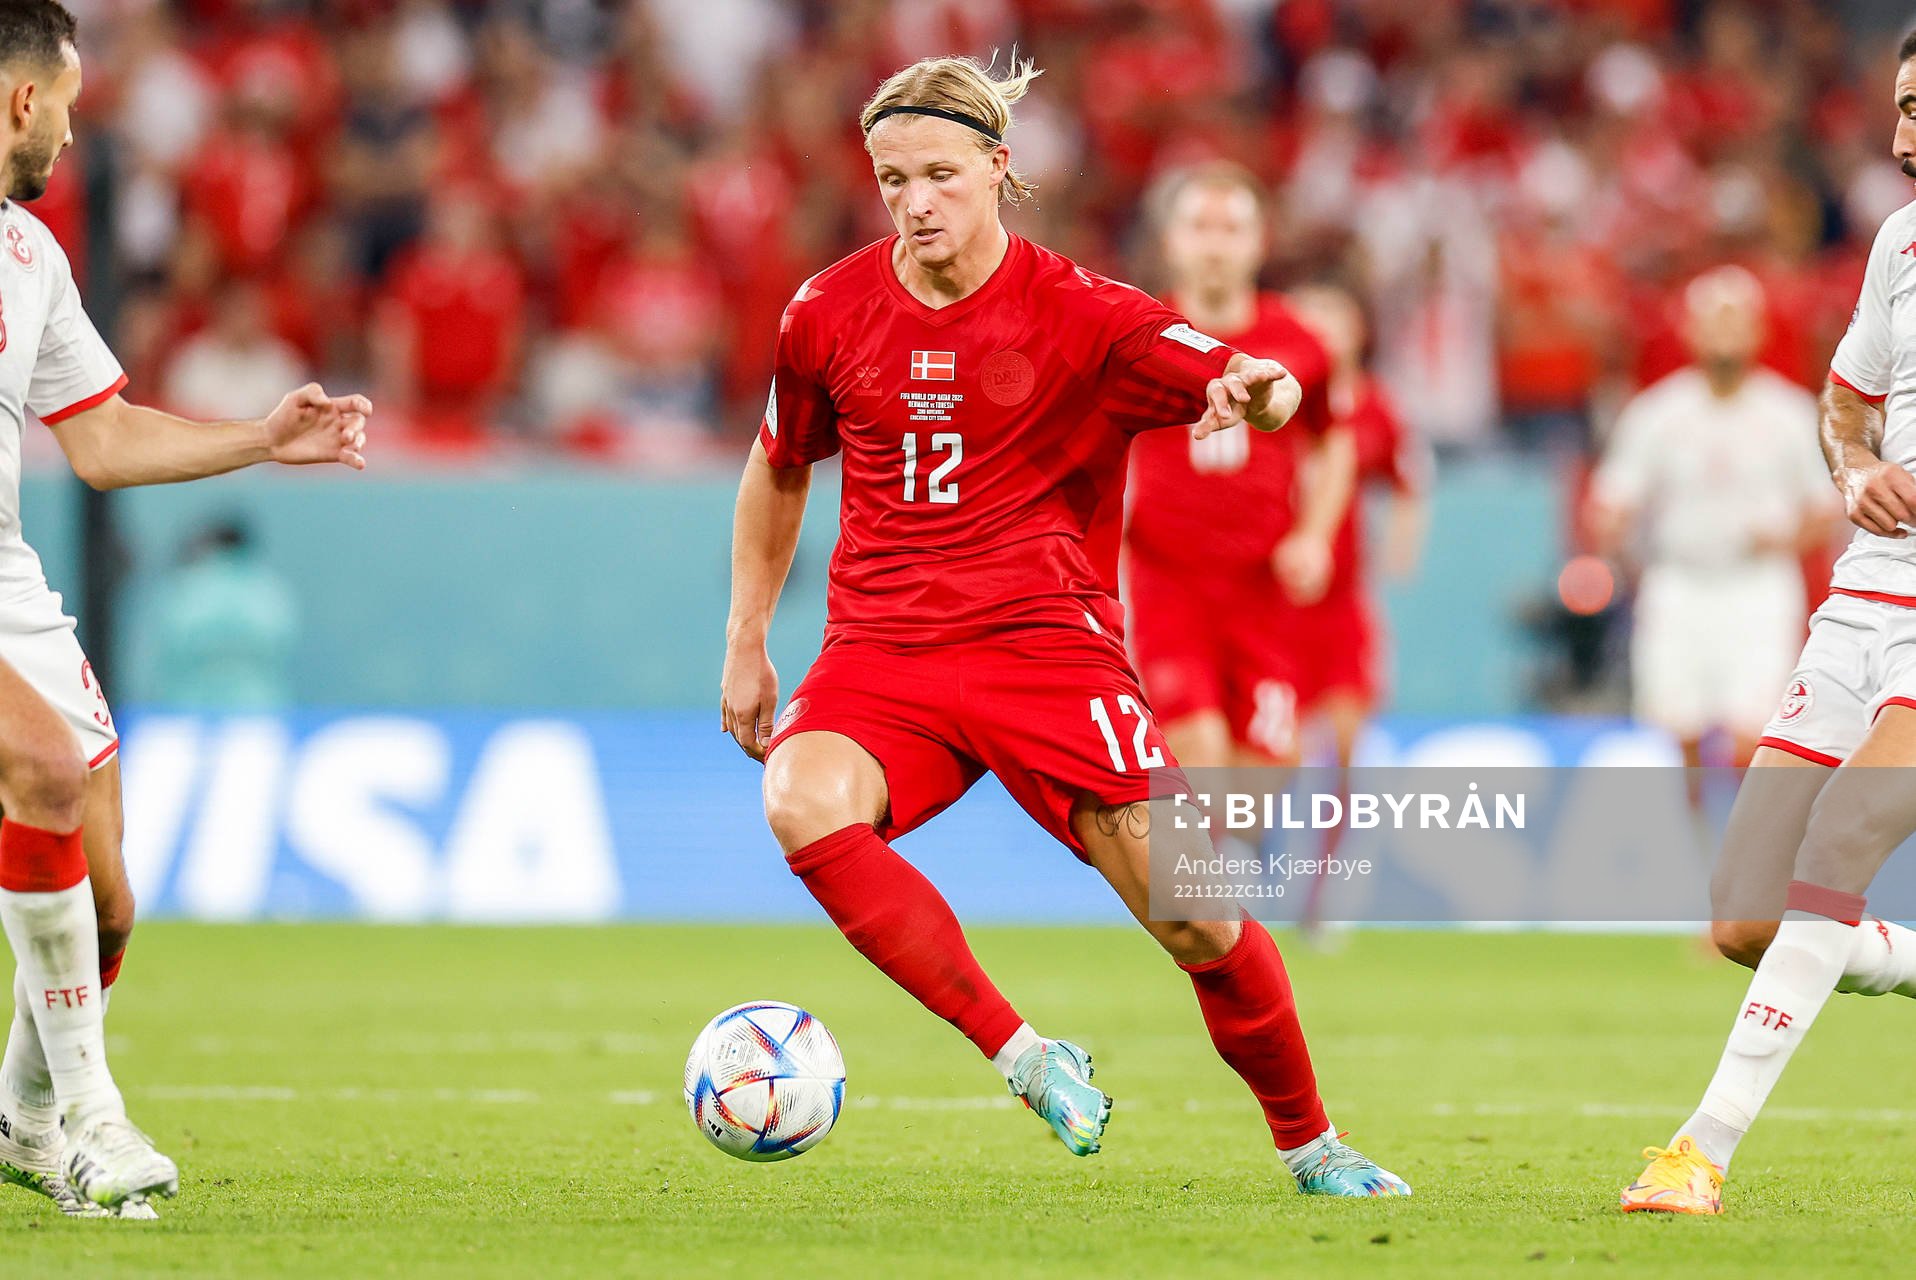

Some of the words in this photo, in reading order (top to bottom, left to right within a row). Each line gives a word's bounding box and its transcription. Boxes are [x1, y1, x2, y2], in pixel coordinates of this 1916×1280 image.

[901, 432, 964, 503] 12
[1089, 694, 1166, 773] 12
[44, 985, 88, 1010] FTF
[1744, 1002, 1793, 1031] FTF
